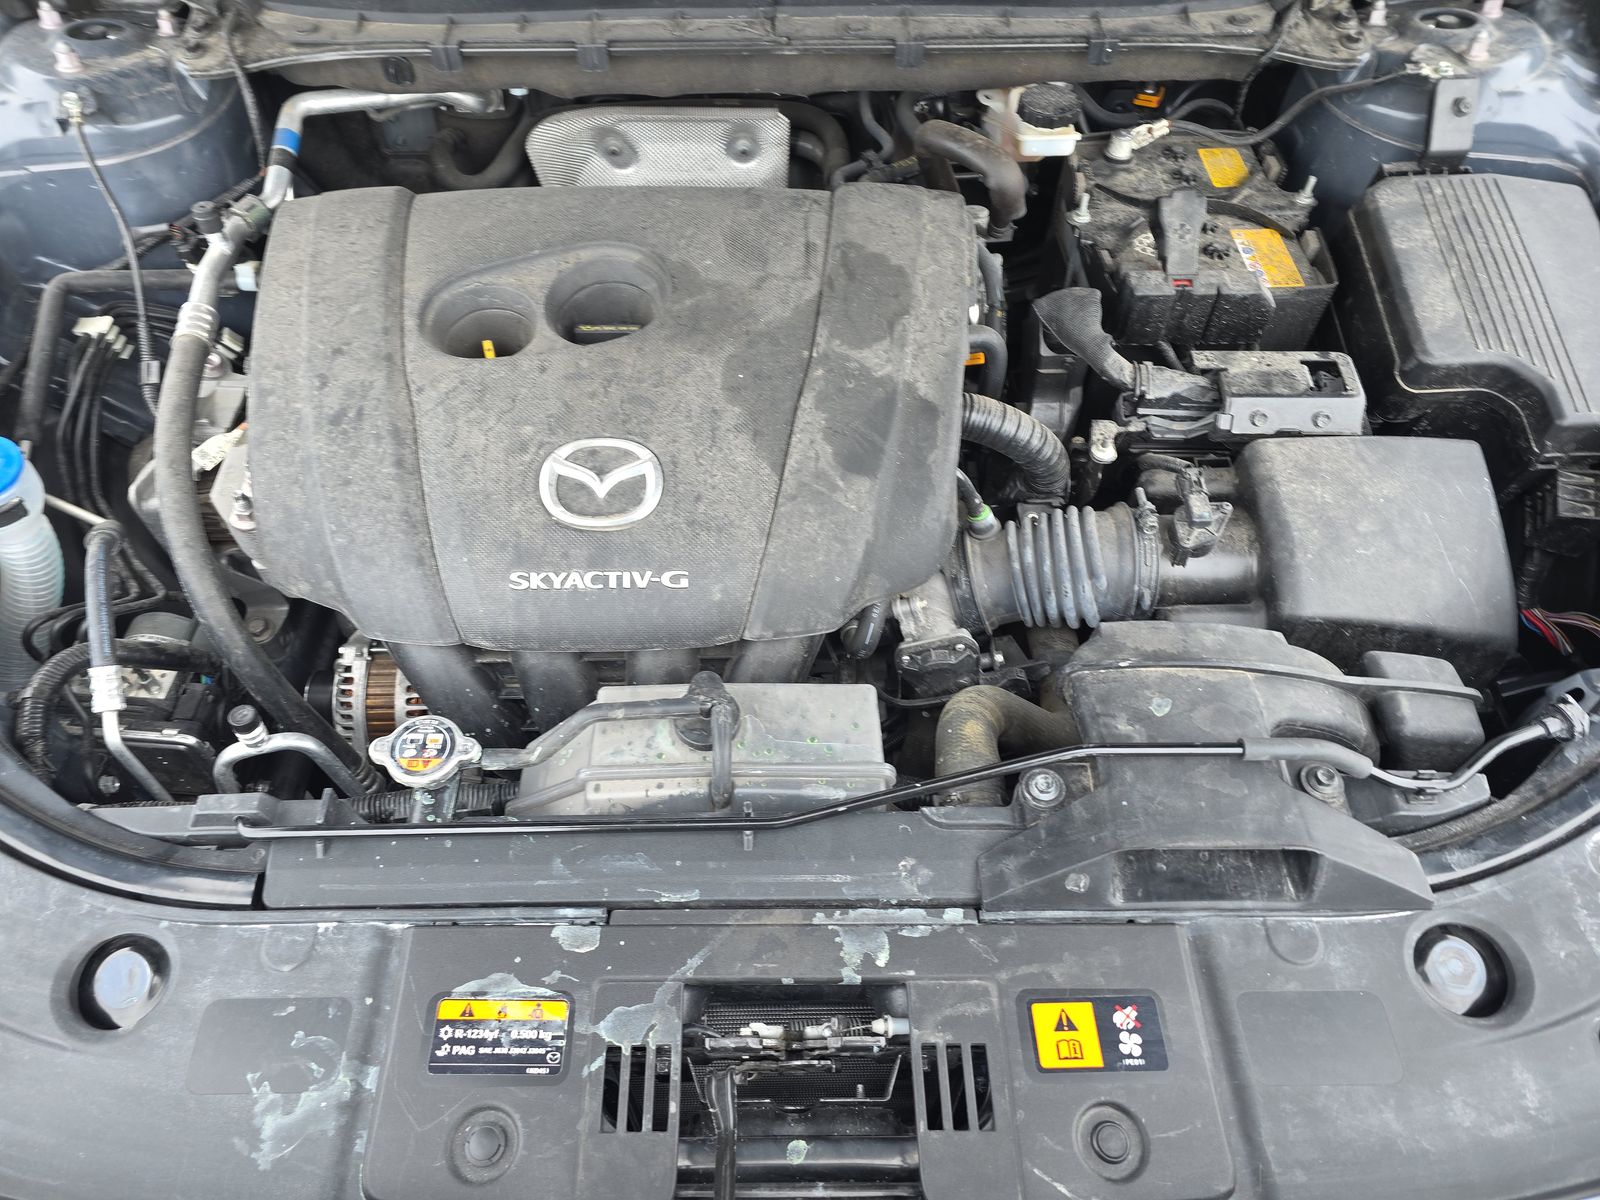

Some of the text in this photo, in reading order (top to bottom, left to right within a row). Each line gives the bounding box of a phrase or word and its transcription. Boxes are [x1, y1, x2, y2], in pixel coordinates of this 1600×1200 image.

[508, 570, 690, 590] SKYACTIV-G
[510, 1029, 537, 1039] 0.500
[539, 1029, 552, 1041] kg
[452, 1045, 475, 1055] PAG
